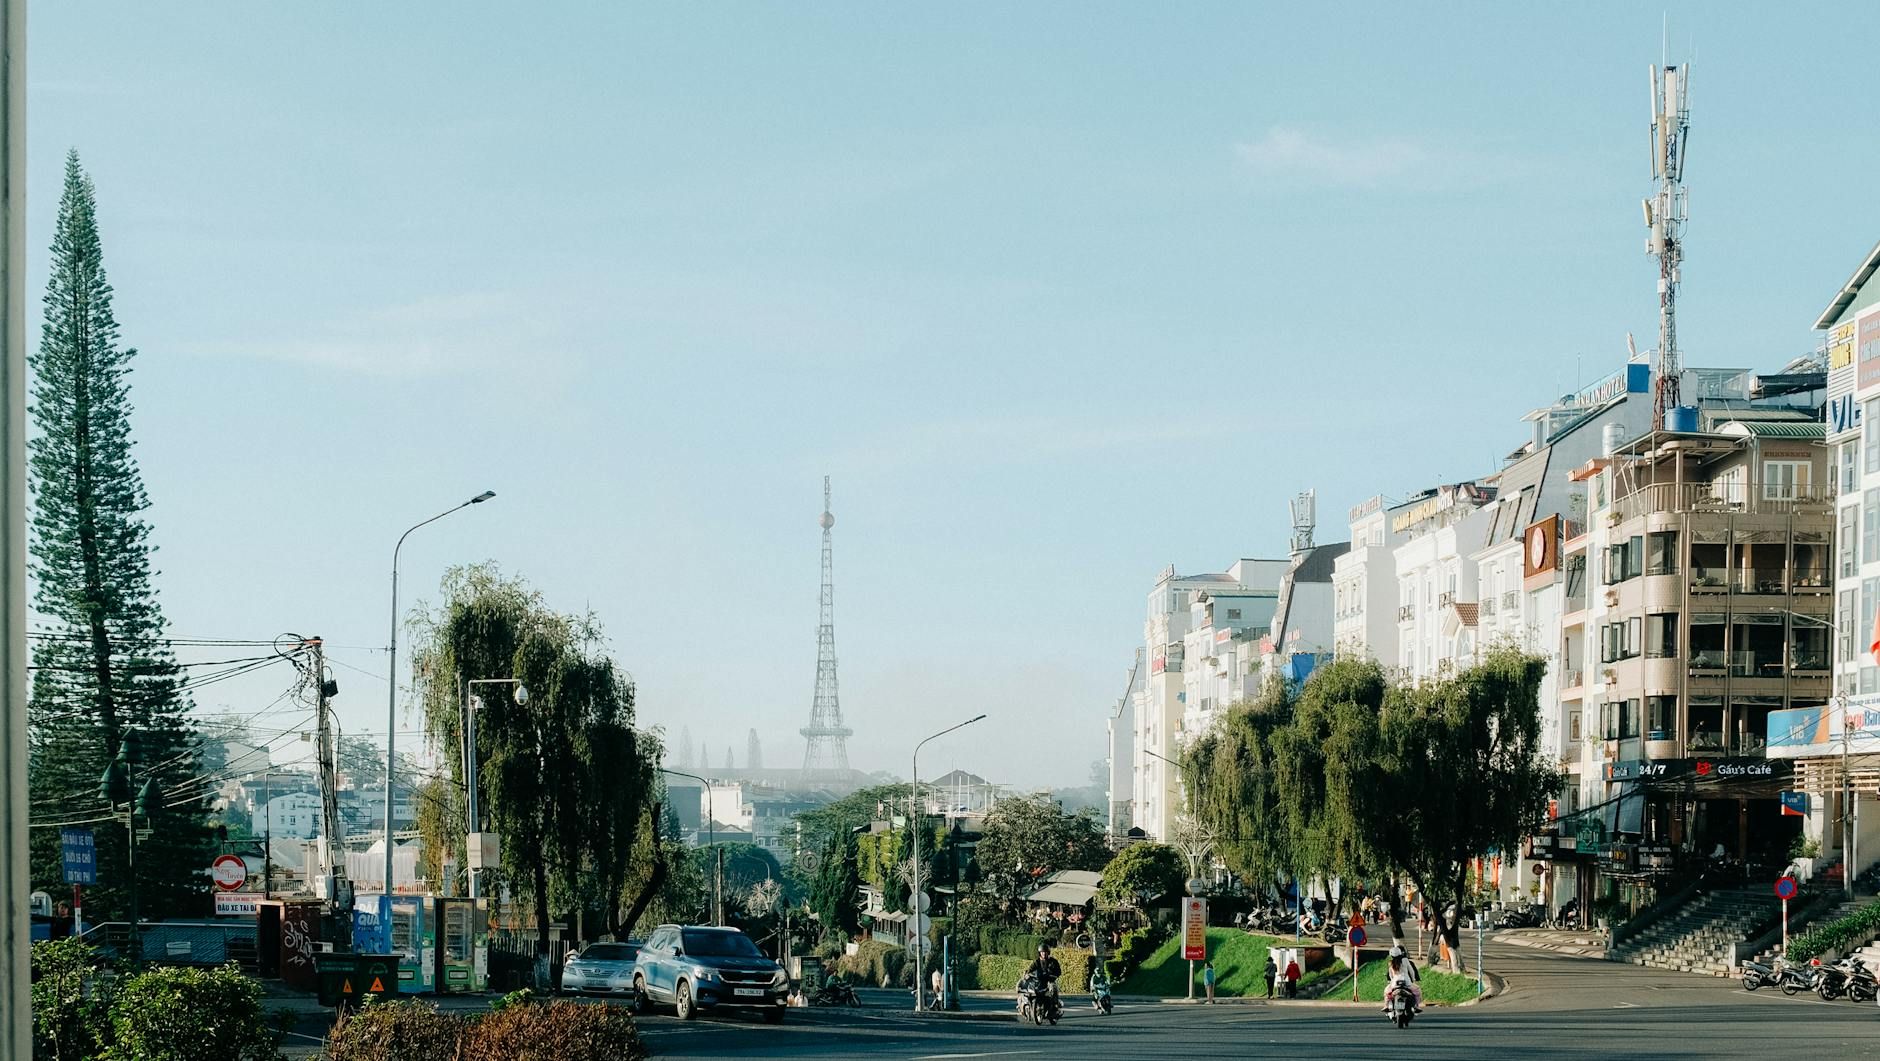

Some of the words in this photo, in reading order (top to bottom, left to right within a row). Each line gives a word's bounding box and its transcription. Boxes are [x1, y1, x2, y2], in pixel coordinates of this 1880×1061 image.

[1601, 374, 1626, 402] HOTEL
[1639, 764, 1667, 776] 24/7
[1749, 764, 1772, 775] Café
[78, 835, 85, 846] XE
[230, 904, 239, 912] XE
